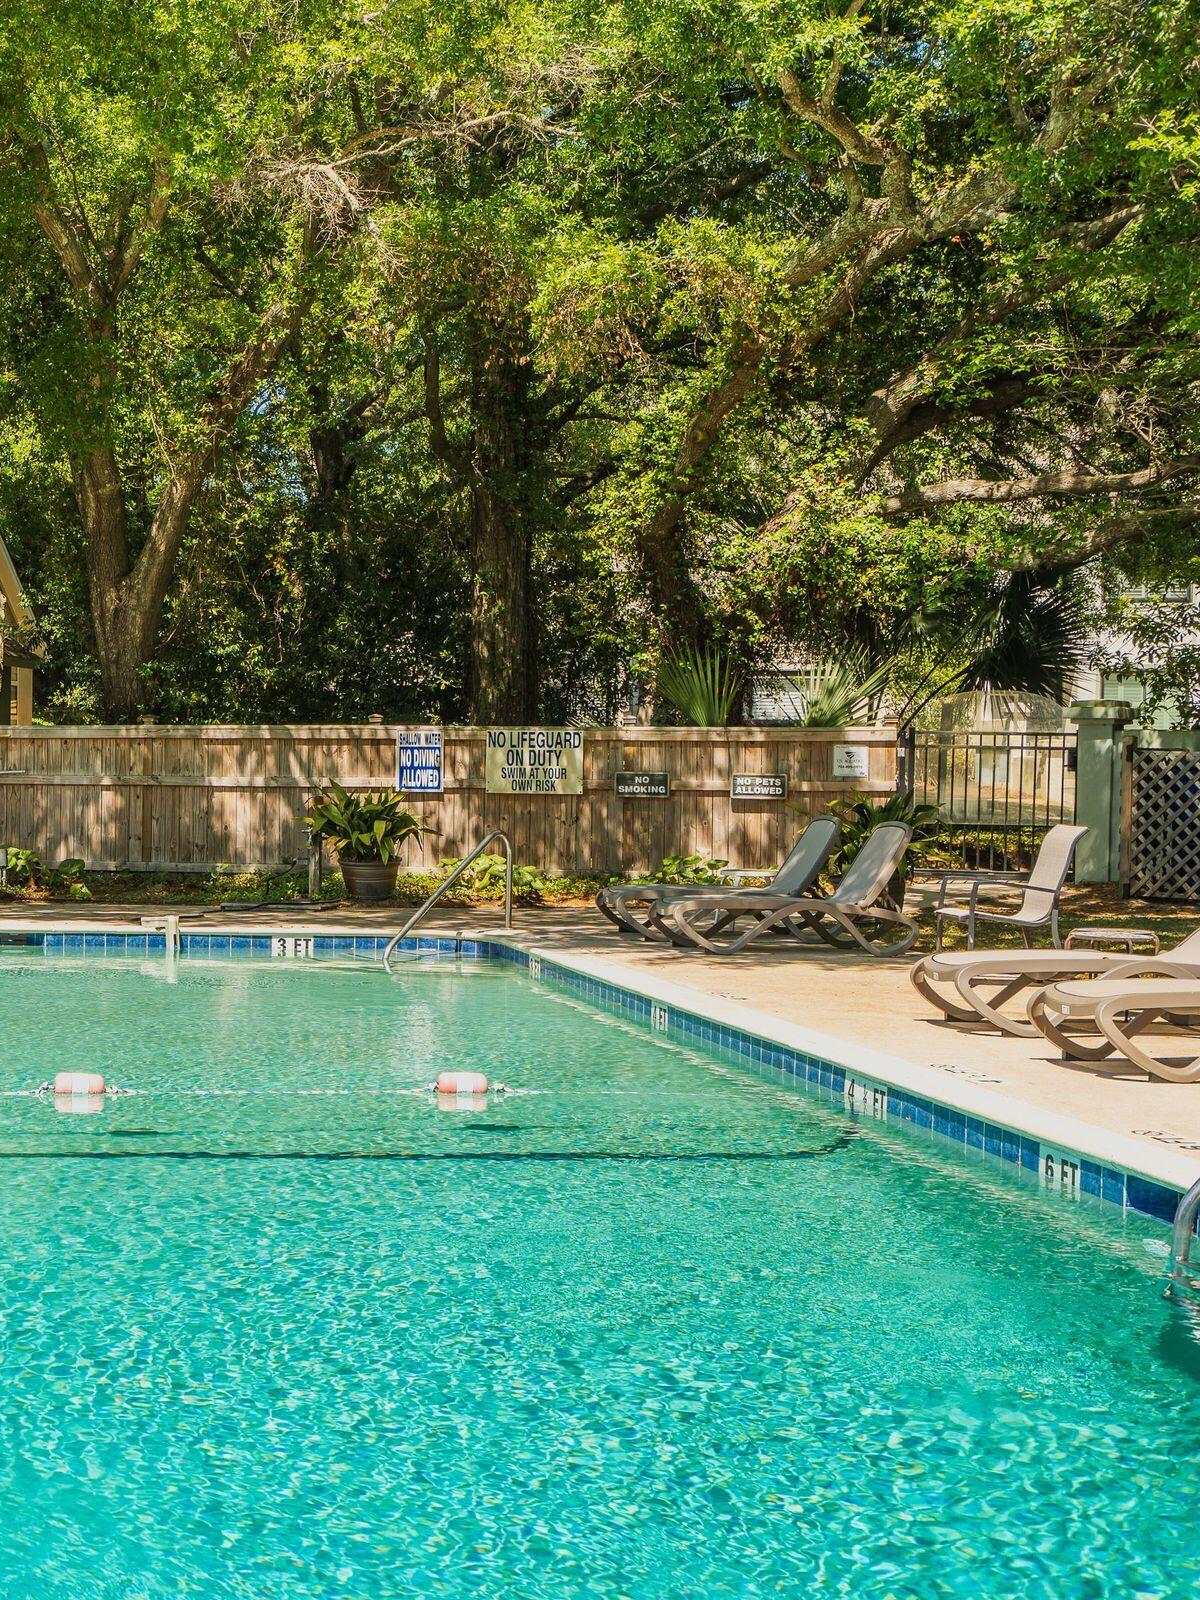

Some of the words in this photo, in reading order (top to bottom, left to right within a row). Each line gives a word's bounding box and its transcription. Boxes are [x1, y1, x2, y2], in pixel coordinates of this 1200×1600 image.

[399, 732, 421, 746] SHALLOW
[424, 732, 441, 746] WATER
[488, 731, 506, 748] NO
[509, 731, 581, 749] LIFEGUARD
[400, 748, 412, 767] NO
[413, 748, 440, 767] DIVING
[506, 749, 527, 766] ON
[528, 749, 563, 767] DUTY
[401, 768, 439, 788] ALLOWED
[501, 767, 527, 780] SWIM
[528, 767, 540, 780] AT
[541, 767, 567, 780] YOUR
[634, 776, 650, 784] NO
[511, 779, 533, 792] OWN
[535, 779, 557, 792] RISK
[736, 777, 754, 786] NO
[756, 778, 782, 786] PETS
[618, 785, 666, 793] SMOKING
[735, 786, 783, 795] ALLOWED
[294, 938, 312, 949] FT
[848, 1078, 855, 1097] 4
[873, 1087, 886, 1109] FT
[1045, 1154, 1055, 1177] 6
[1061, 1158, 1079, 1186] FT
